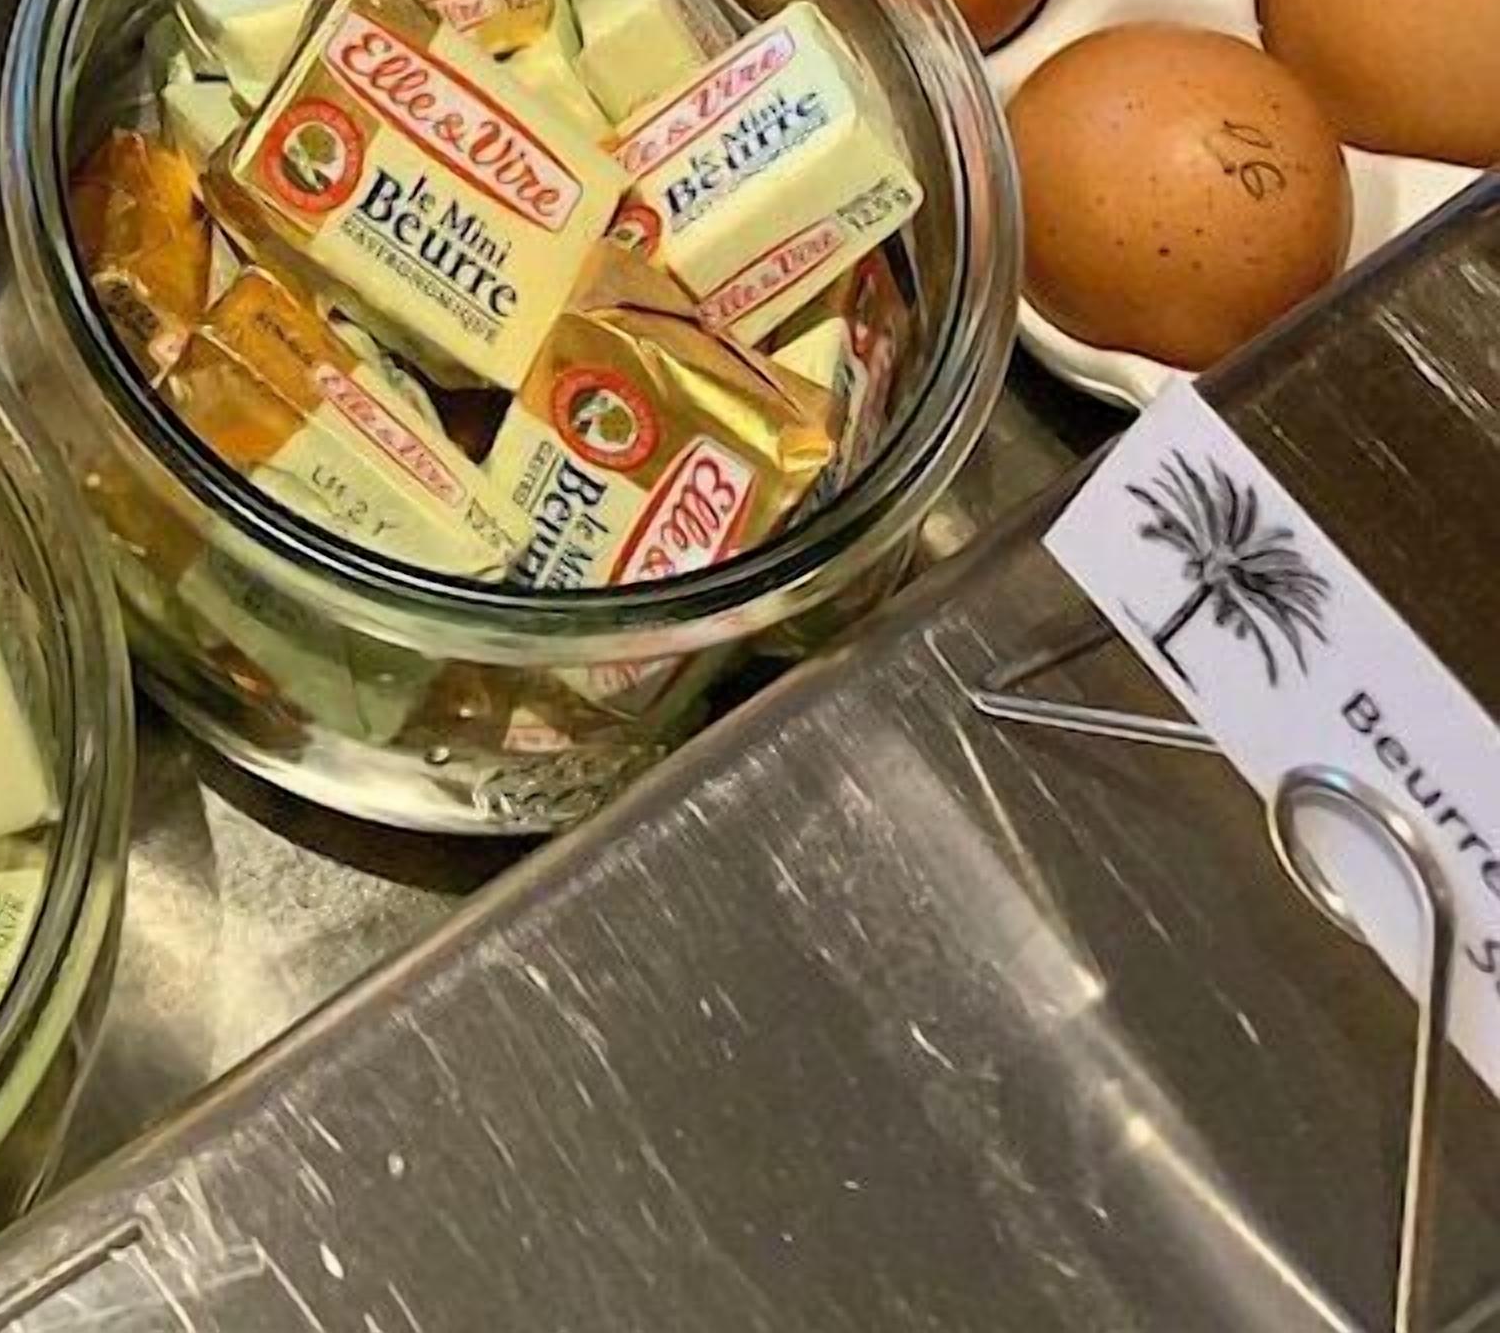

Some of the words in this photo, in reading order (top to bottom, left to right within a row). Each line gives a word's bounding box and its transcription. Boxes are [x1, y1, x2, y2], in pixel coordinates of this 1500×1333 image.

[341, 33, 437, 121] Elle
[433, 113, 466, 153] &
[469, 120, 560, 216] Vire
[693, 46, 792, 119] Vire
[666, 91, 824, 216] Beurre
[356, 168, 519, 317] Beurre
[408, 175, 436, 212] le
[439, 198, 513, 268] Mini
[659, 455, 738, 555] Elle
[1342, 691, 1500, 903] Beurre
